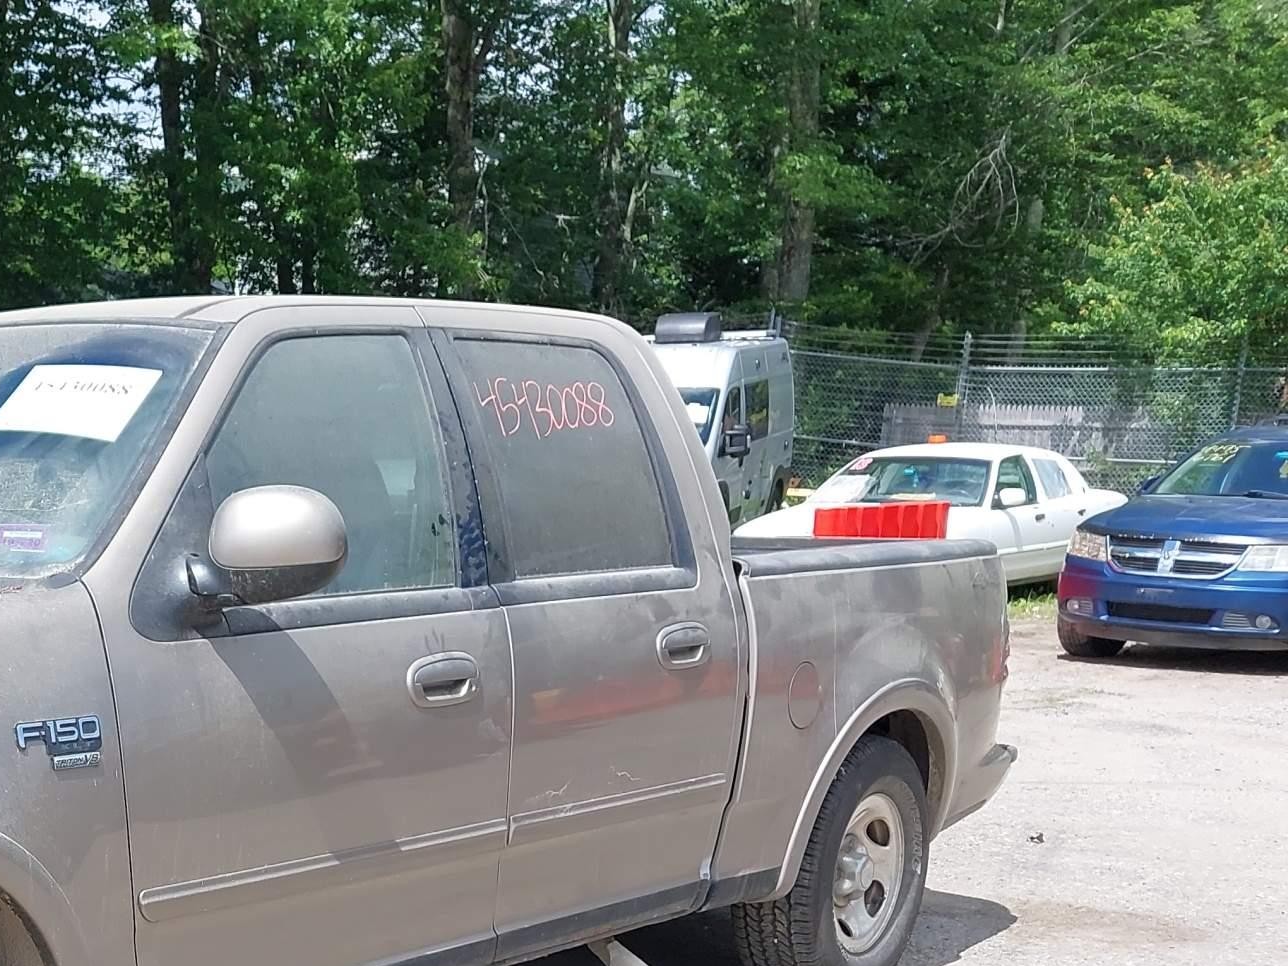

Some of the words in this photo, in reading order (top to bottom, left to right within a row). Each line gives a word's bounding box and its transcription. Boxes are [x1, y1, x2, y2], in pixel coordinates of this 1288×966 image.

[473, 377, 614, 440] 45430088
[16, 716, 100, 749] F-150
[56, 757, 84, 769] TRITON
